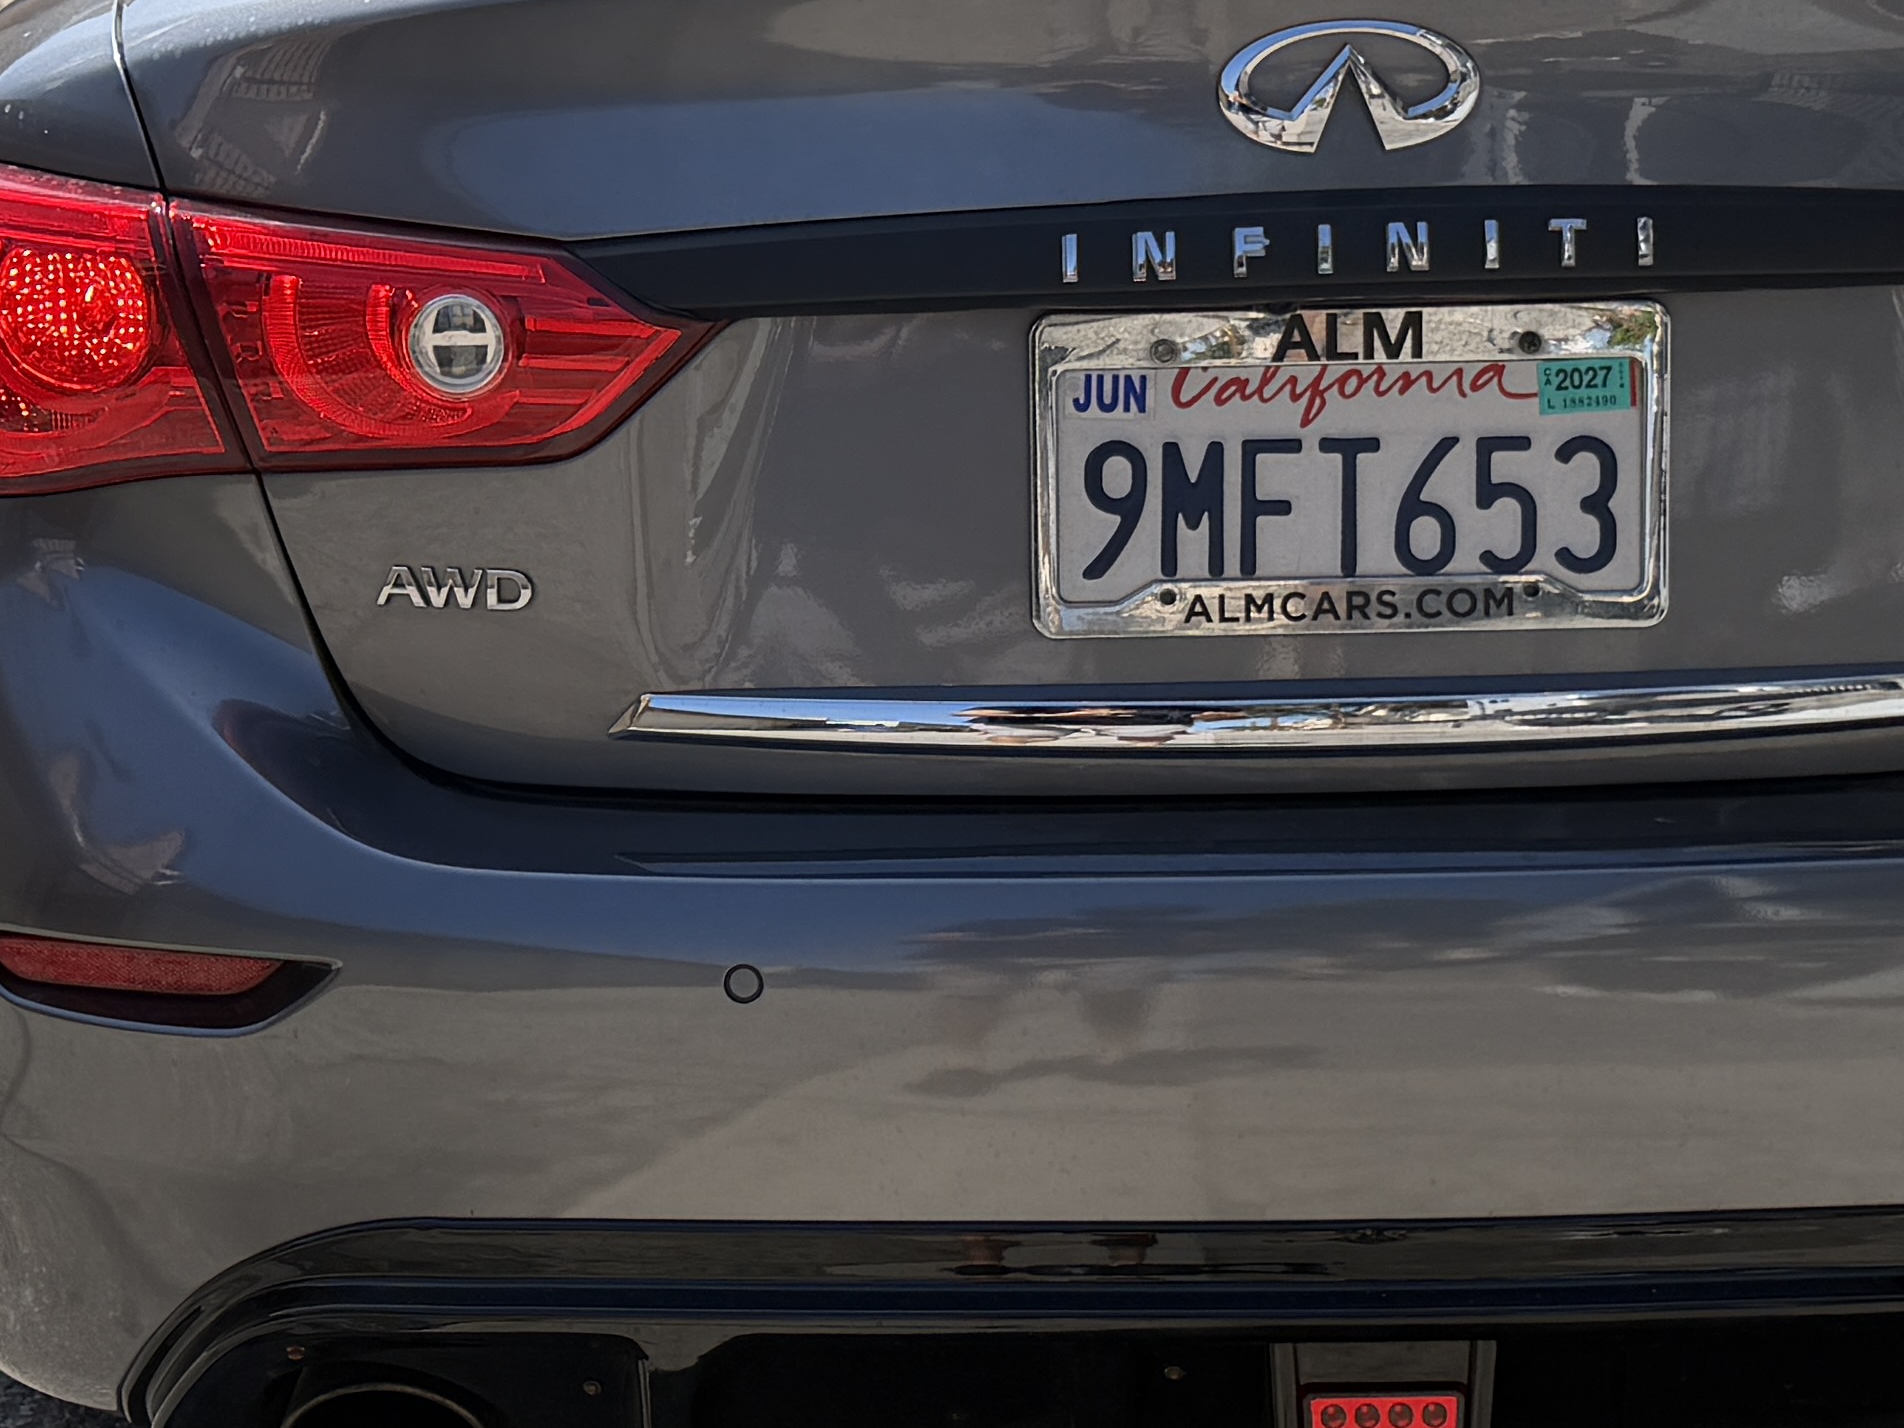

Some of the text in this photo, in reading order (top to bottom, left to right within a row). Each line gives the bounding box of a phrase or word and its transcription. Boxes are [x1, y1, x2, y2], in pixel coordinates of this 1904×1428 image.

[1061, 217, 1654, 283] INFINITI
[1271, 310, 1423, 363] ALM
[1072, 373, 1147, 414] JUN
[1171, 363, 1538, 429] California
[1555, 365, 1612, 391] 2027
[1083, 435, 1618, 581] 9MFT653
[376, 565, 533, 611] AWD
[1183, 586, 1514, 624] ALMCARS.COM
